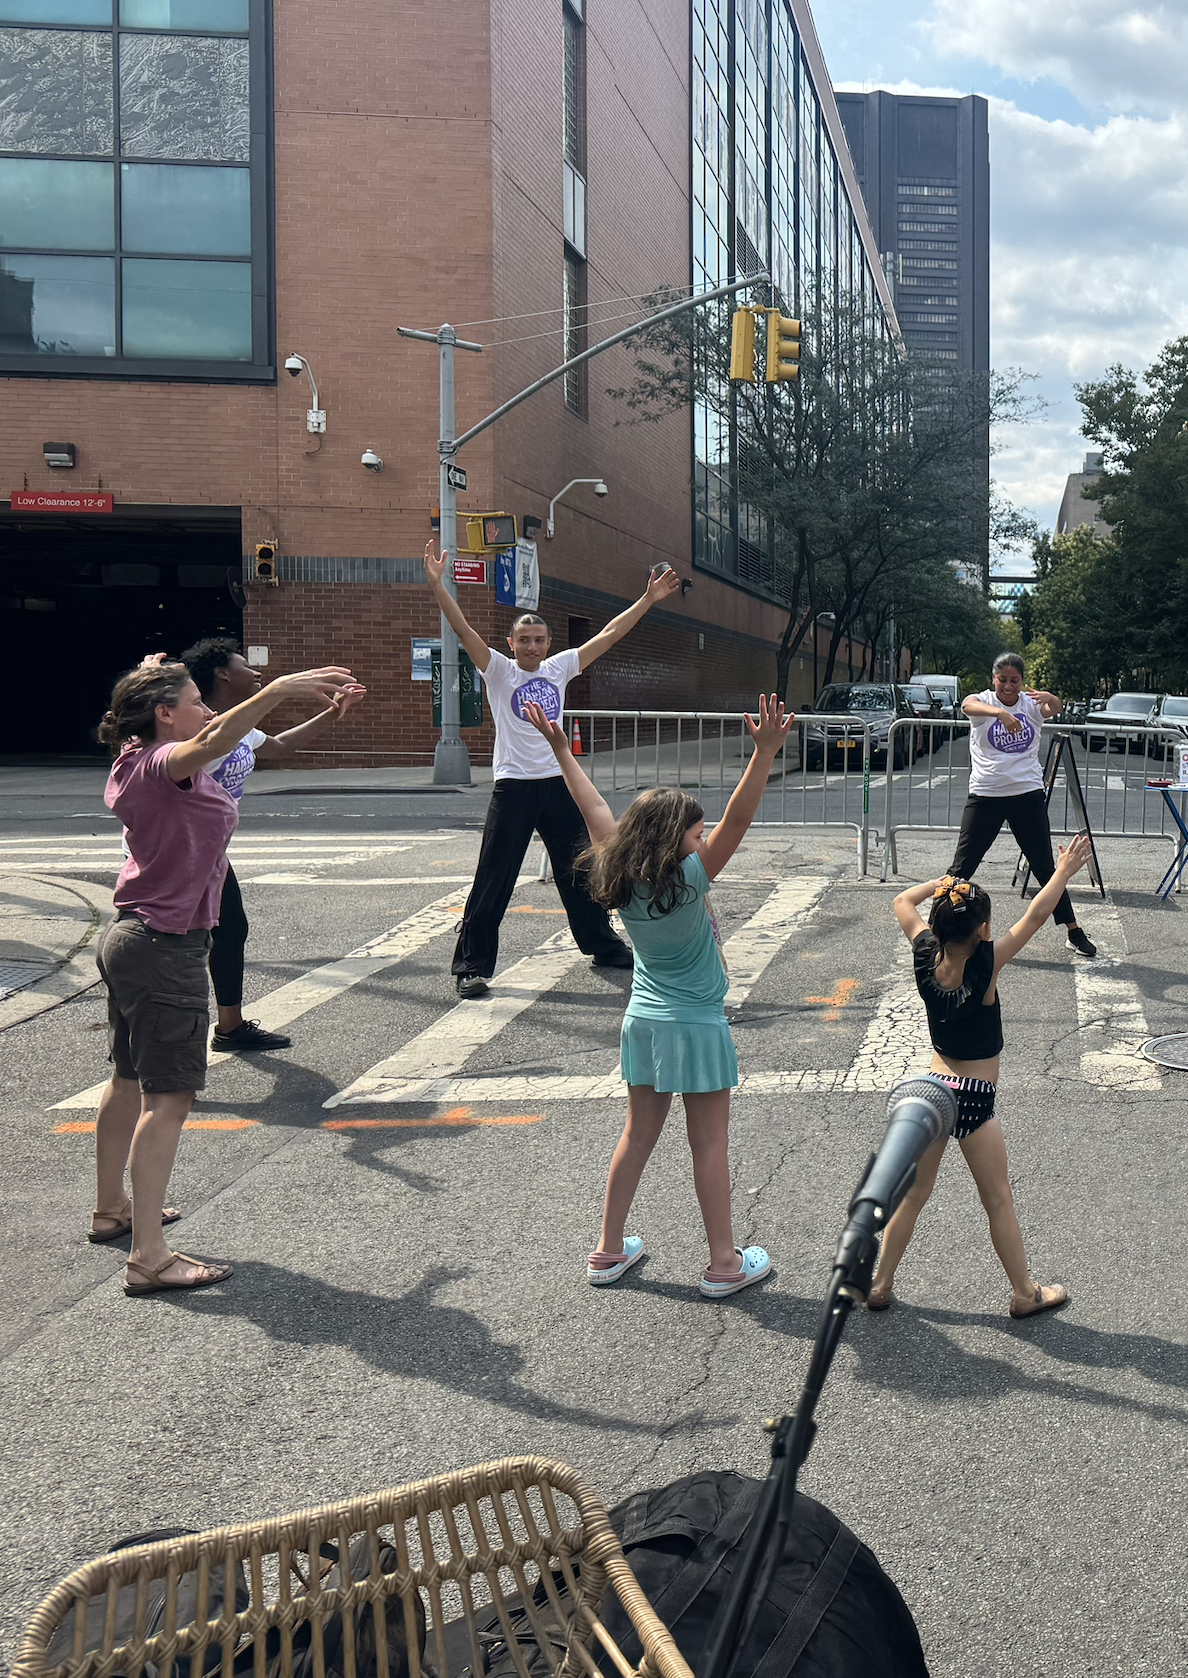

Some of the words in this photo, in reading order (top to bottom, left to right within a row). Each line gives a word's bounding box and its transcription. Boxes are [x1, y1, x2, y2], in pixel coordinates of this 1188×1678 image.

[17, 496, 35, 505] Low
[37, 497, 80, 507] Clearance
[83, 498, 106, 508] 12'-6"
[526, 681, 541, 692] THE
[516, 685, 556, 704] HARLEM
[993, 727, 1032, 748] PROJECT
